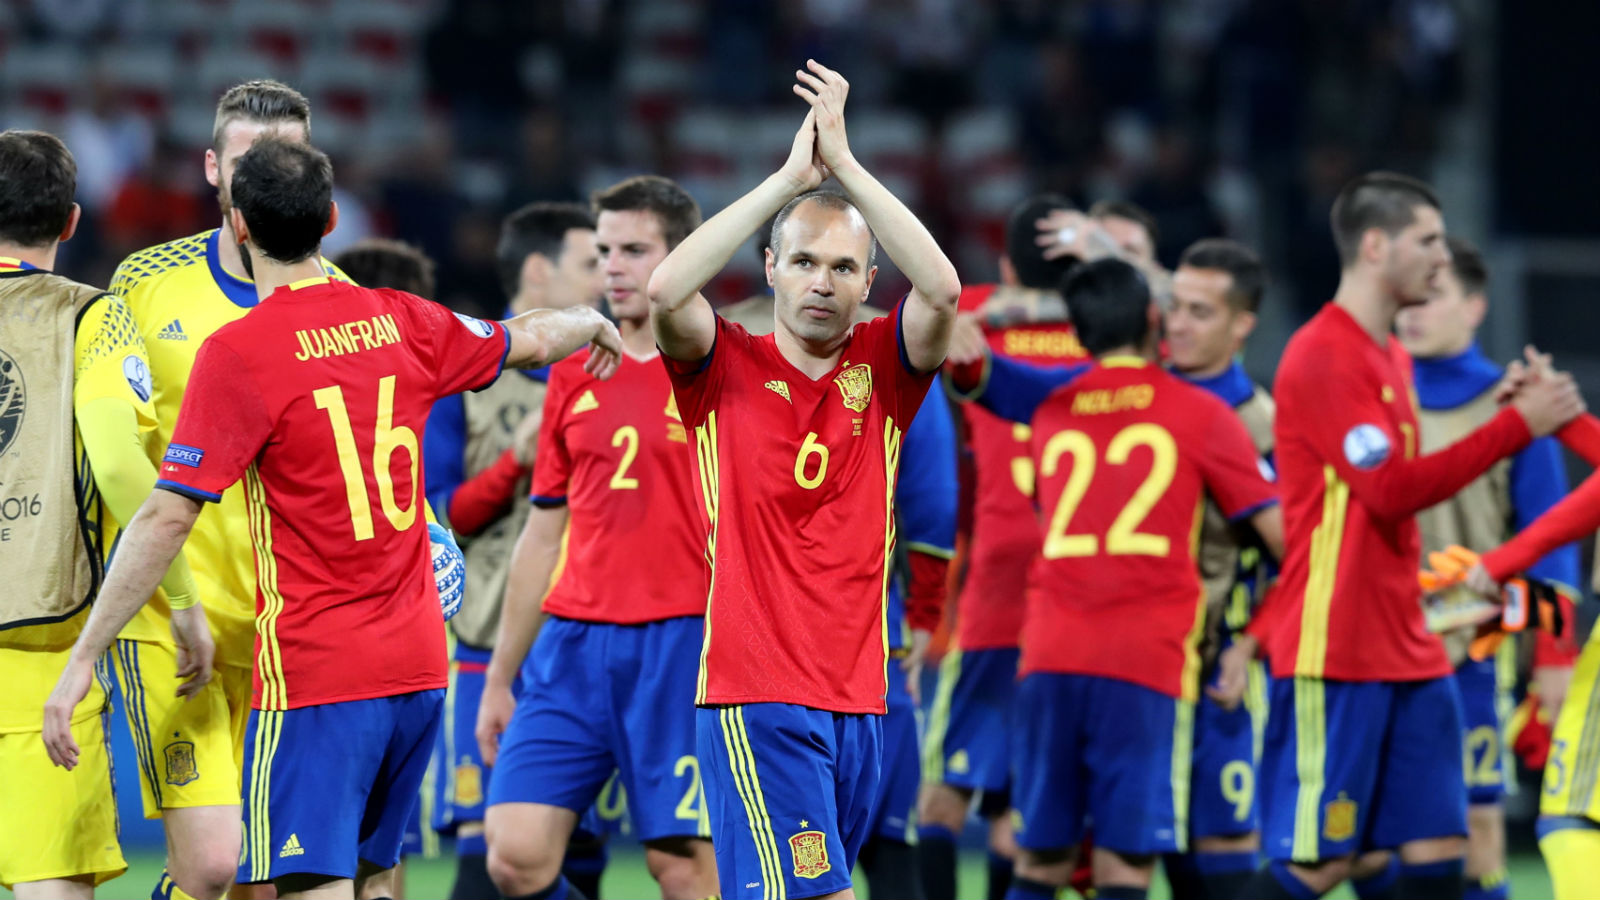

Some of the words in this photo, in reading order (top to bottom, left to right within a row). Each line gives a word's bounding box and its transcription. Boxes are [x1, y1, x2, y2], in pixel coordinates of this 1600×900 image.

[157, 332, 188, 341] adidas
[295, 313, 402, 361] JUANFRAN
[1071, 384, 1155, 416] NOLITO
[312, 375, 419, 541] 16
[610, 425, 639, 490] 2
[794, 431, 830, 490] 6
[0, 493, 42, 520] 016
[1041, 422, 1177, 560] 22
[673, 755, 699, 819] 2
[1220, 760, 1255, 822] 9
[279, 847, 305, 858] adidas
